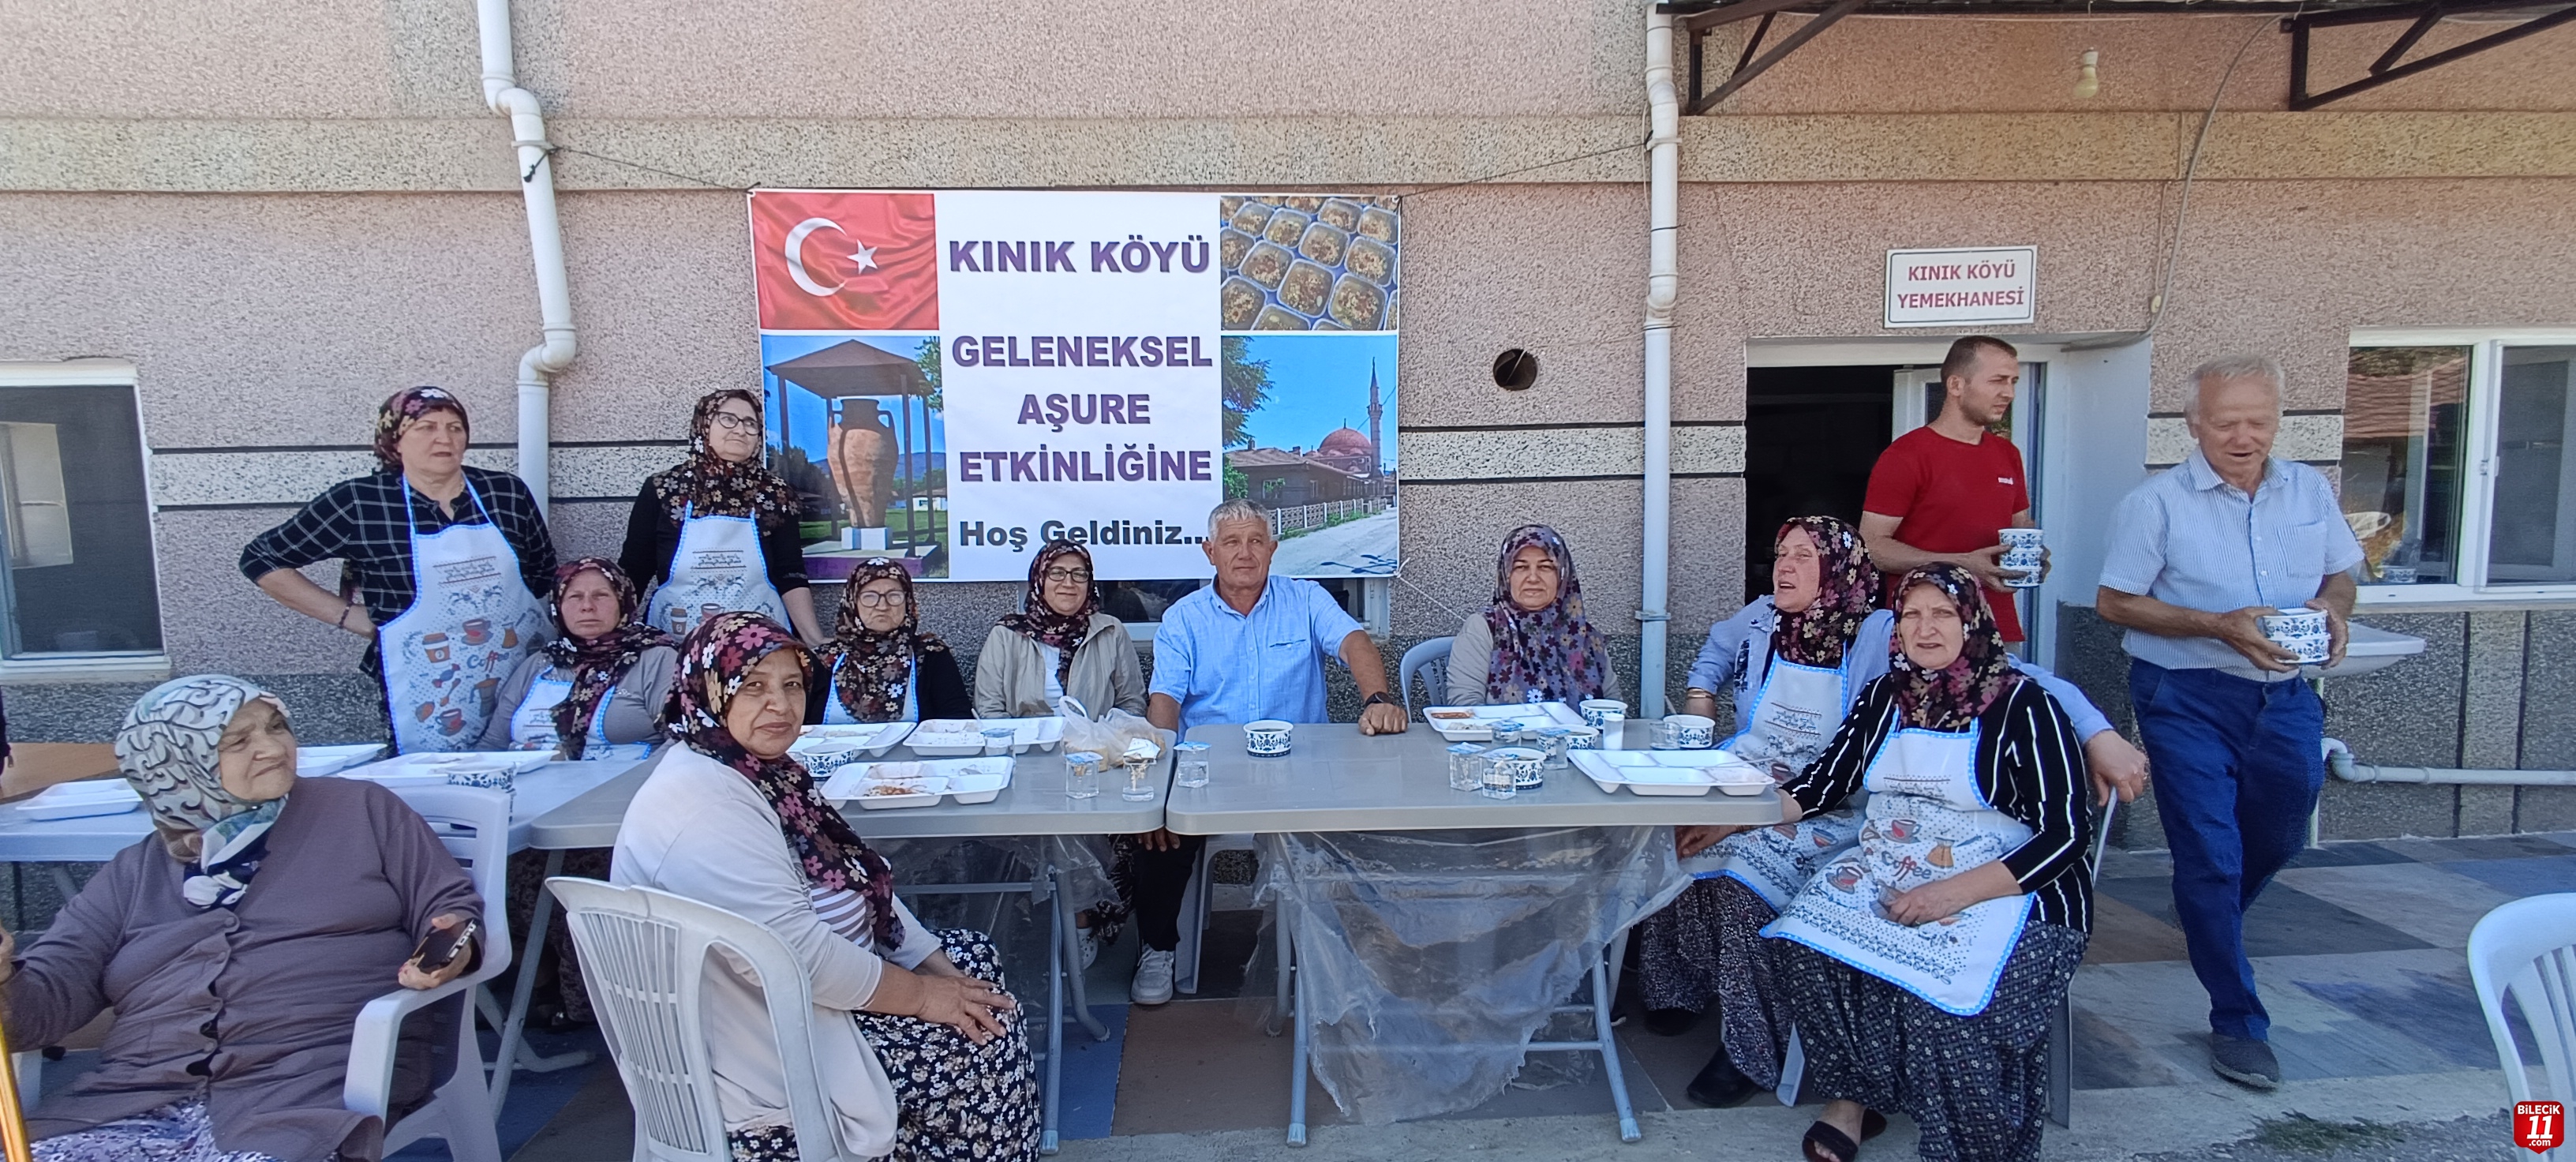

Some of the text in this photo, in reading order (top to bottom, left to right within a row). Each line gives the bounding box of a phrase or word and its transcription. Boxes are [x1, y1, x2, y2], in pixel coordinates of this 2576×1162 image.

[949, 234, 1210, 273] KINIK KÖYÜ
[1908, 259, 2015, 281] KINIK KÖYÜ
[1897, 286, 2024, 309] YEMEKHANESİ
[952, 335, 1213, 367] GELENEKSEL
[1017, 394, 1151, 433] AŞURE
[960, 444, 1212, 482] ETKİNLİĞİNE
[960, 519, 1209, 553] Hoş Geldiniz..
[1881, 850, 1932, 882] Coffee
